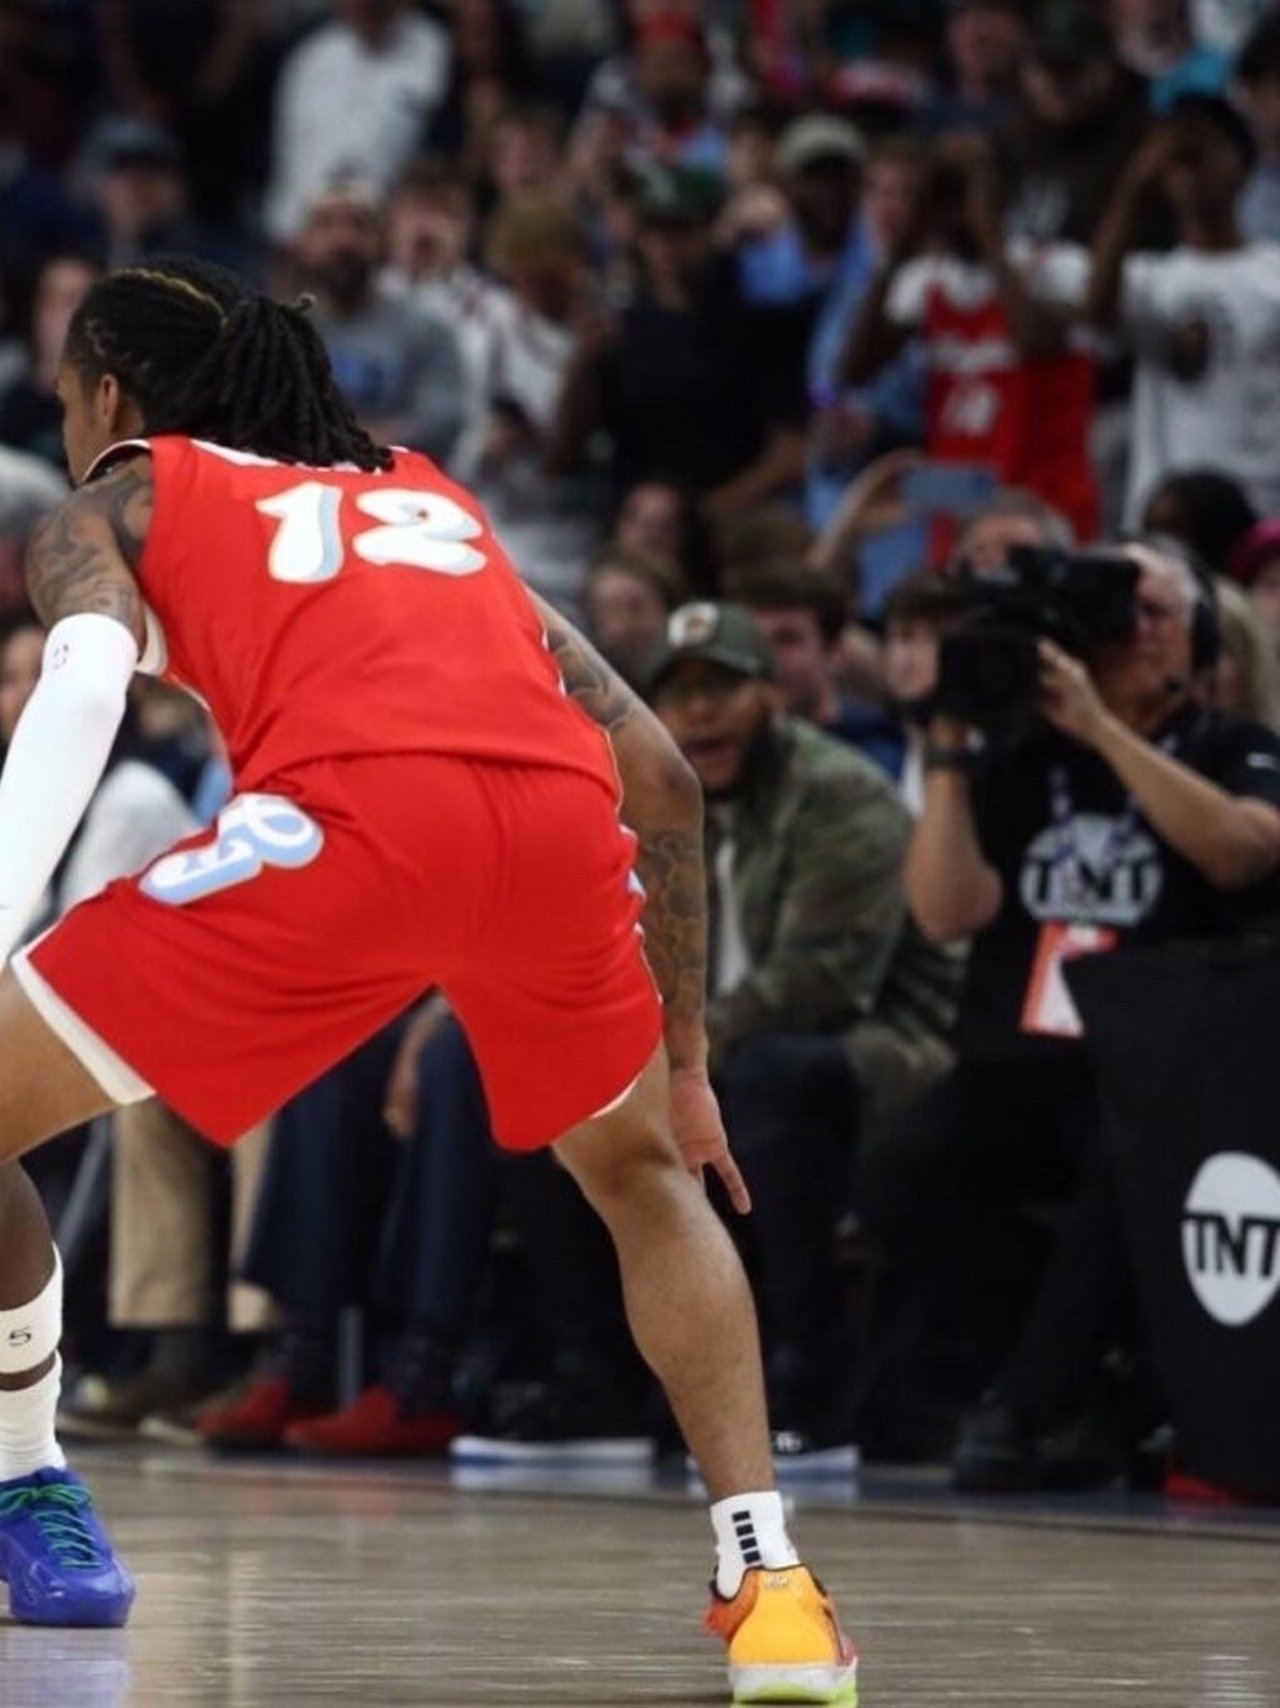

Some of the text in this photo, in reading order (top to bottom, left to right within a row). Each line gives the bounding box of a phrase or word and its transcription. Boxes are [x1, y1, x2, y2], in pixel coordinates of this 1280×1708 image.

[255, 480, 488, 583] 12
[1024, 857, 1162, 902] TNT
[1183, 1211, 1280, 1278] TNT
[9, 1326, 31, 1346] 5
